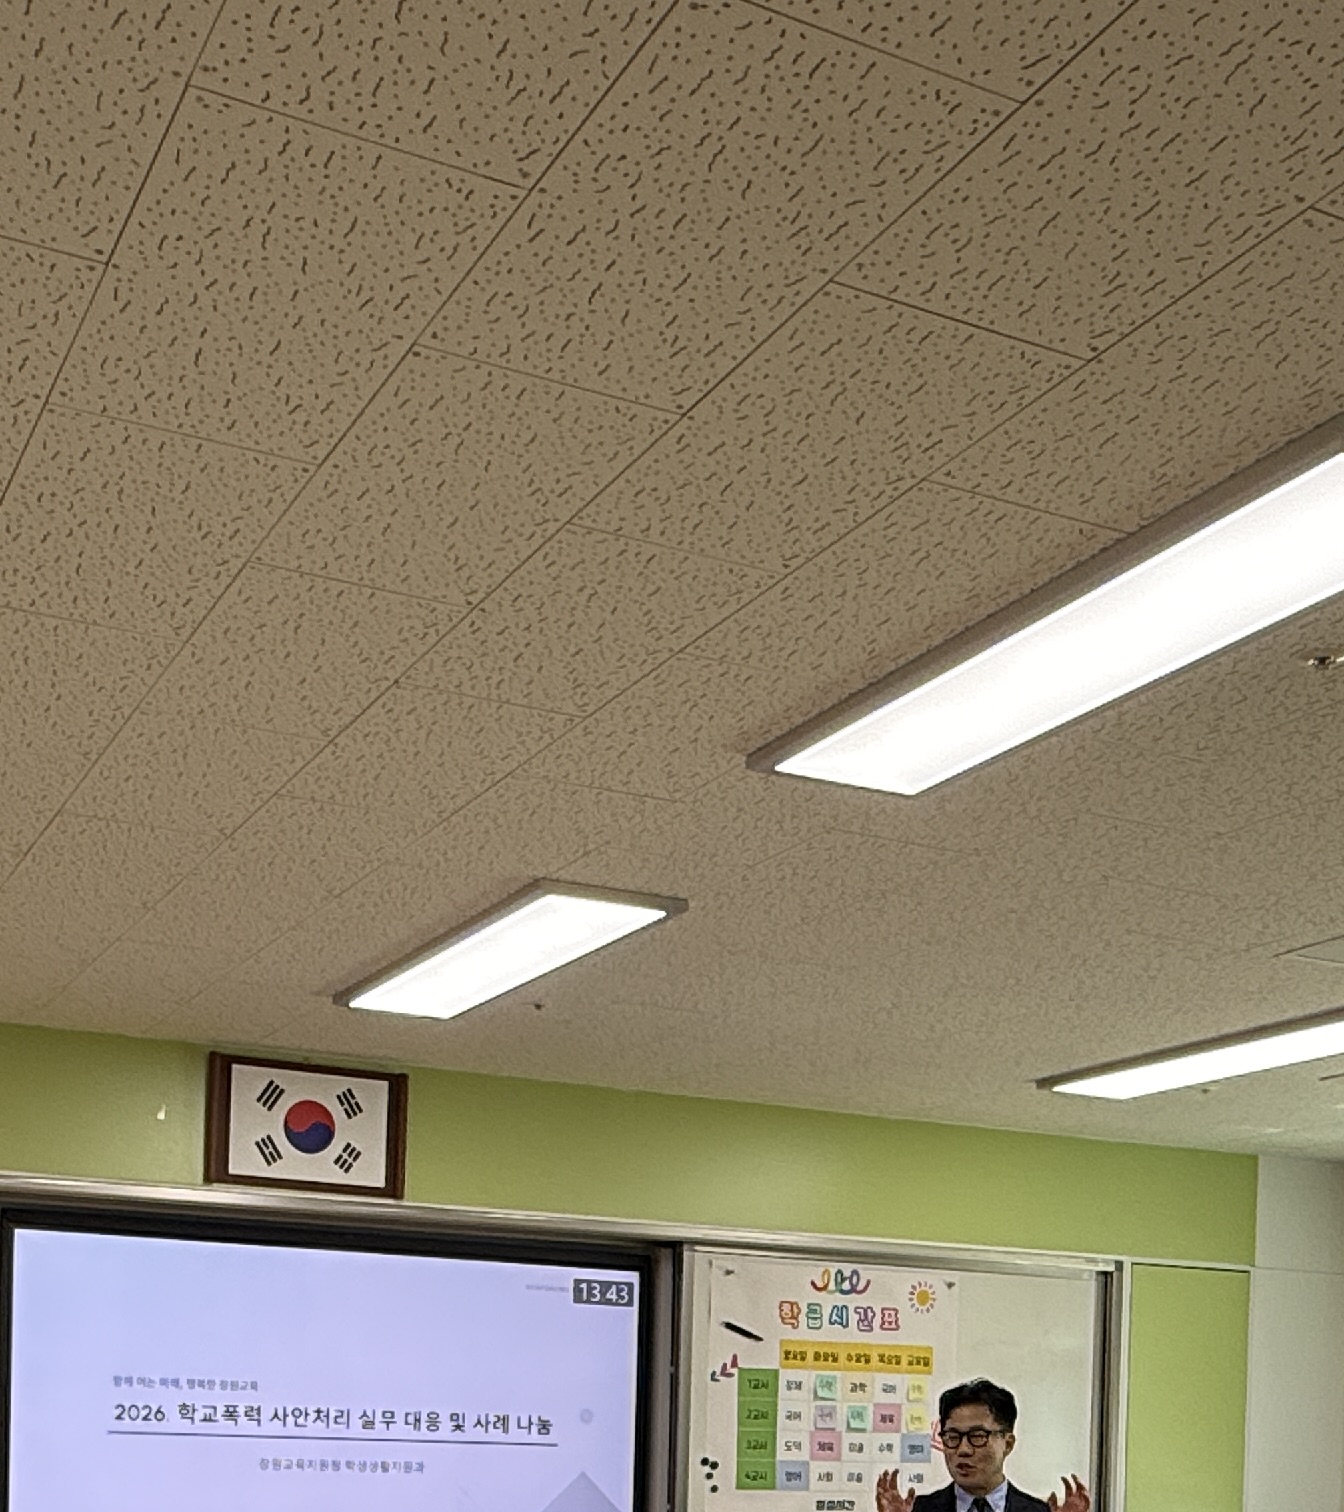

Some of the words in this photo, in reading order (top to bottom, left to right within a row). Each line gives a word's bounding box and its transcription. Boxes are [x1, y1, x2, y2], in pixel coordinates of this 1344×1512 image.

[177, 1402, 262, 1427] 학교폭력
[269, 1405, 351, 1429] 사안처리
[358, 1408, 397, 1431] 실무
[404, 1410, 442, 1432] 대응
[449, 1411, 466, 1433] 및
[472, 1413, 509, 1435] 사례
[517, 1414, 554, 1436] 나눔
[784, 1440, 802, 1452] 도덕
